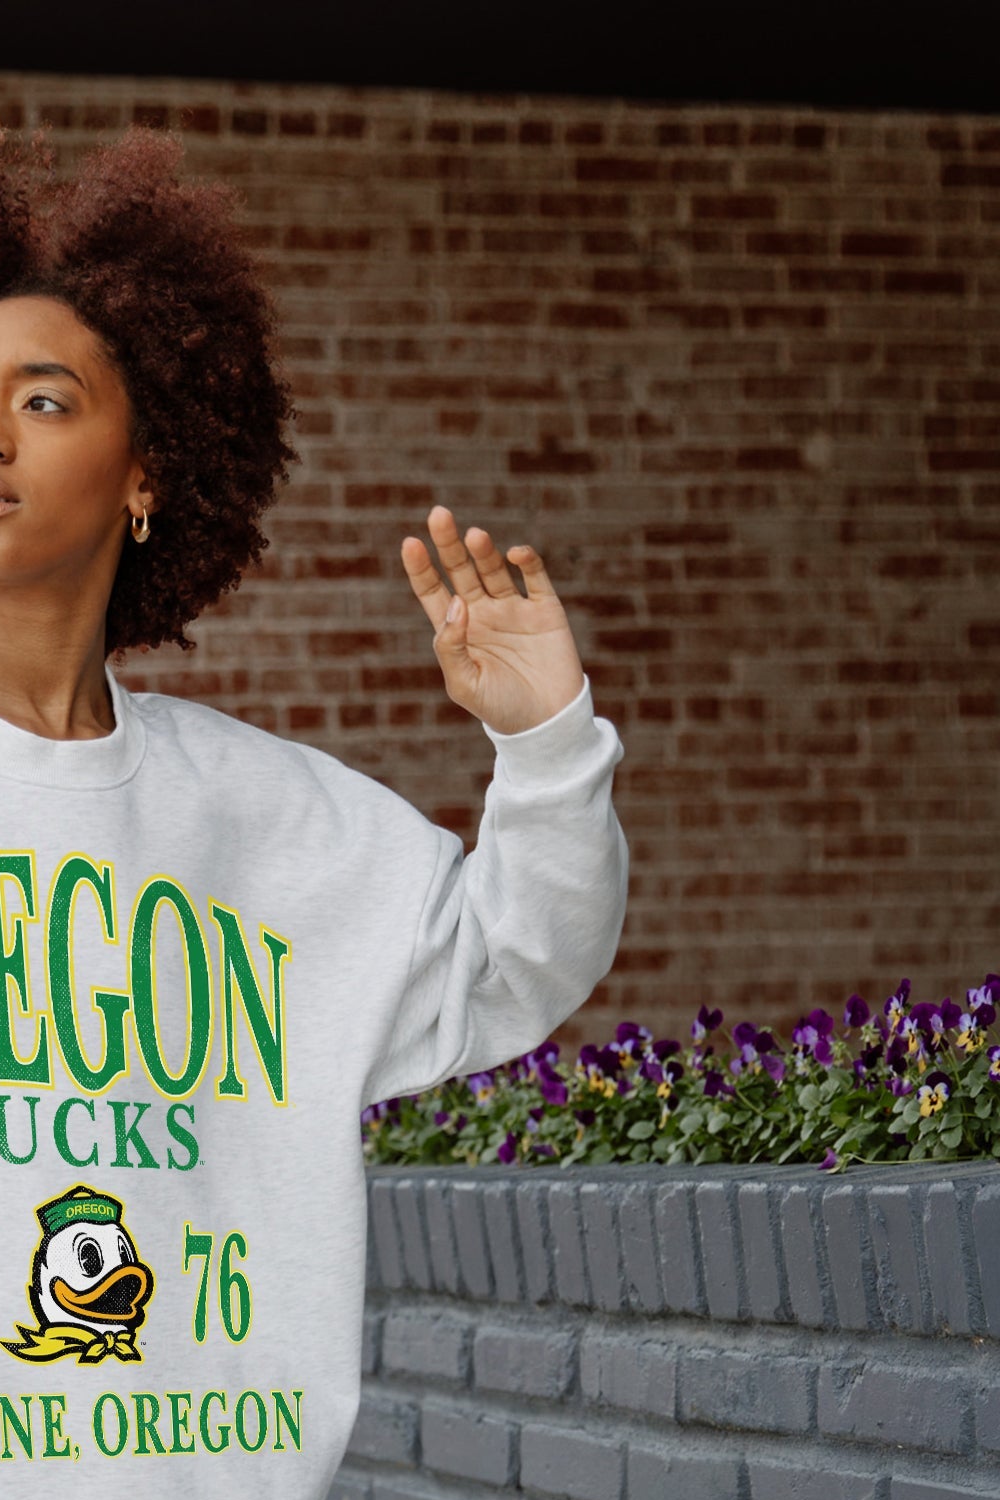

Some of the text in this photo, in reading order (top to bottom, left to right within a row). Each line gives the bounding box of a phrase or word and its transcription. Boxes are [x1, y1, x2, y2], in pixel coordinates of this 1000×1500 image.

[65, 1203, 115, 1219] OREGON
[181, 1217, 253, 1346] 76
[91, 1389, 304, 1459] OREGON
